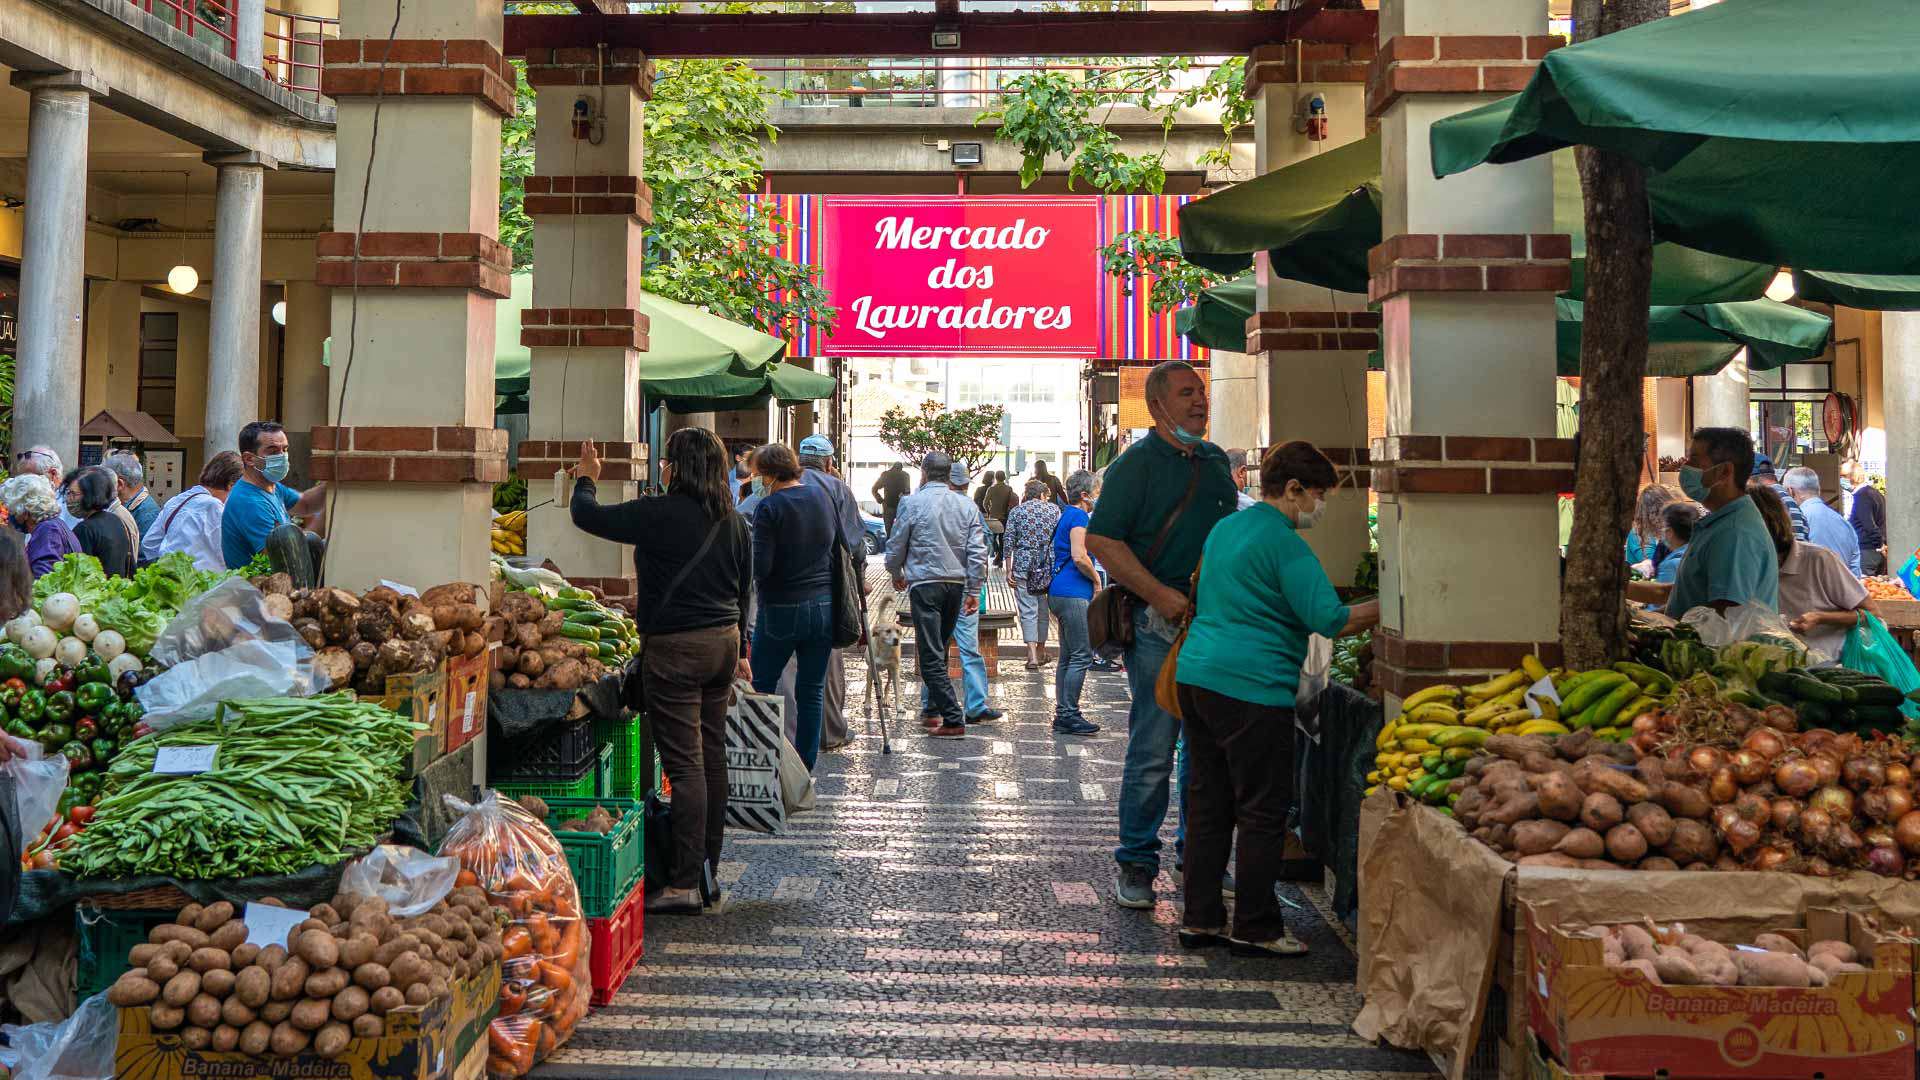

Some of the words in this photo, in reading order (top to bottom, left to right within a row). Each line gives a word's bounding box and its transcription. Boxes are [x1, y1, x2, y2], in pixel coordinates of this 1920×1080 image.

[874, 217, 1051, 250] Mercado
[928, 259, 994, 290] dos
[851, 295, 1072, 339] Lavradores
[1649, 993, 1729, 1013] Banana
[1750, 994, 1837, 1014] Madeira
[183, 1057, 256, 1076] Banana
[272, 1060, 350, 1078] Madeira
